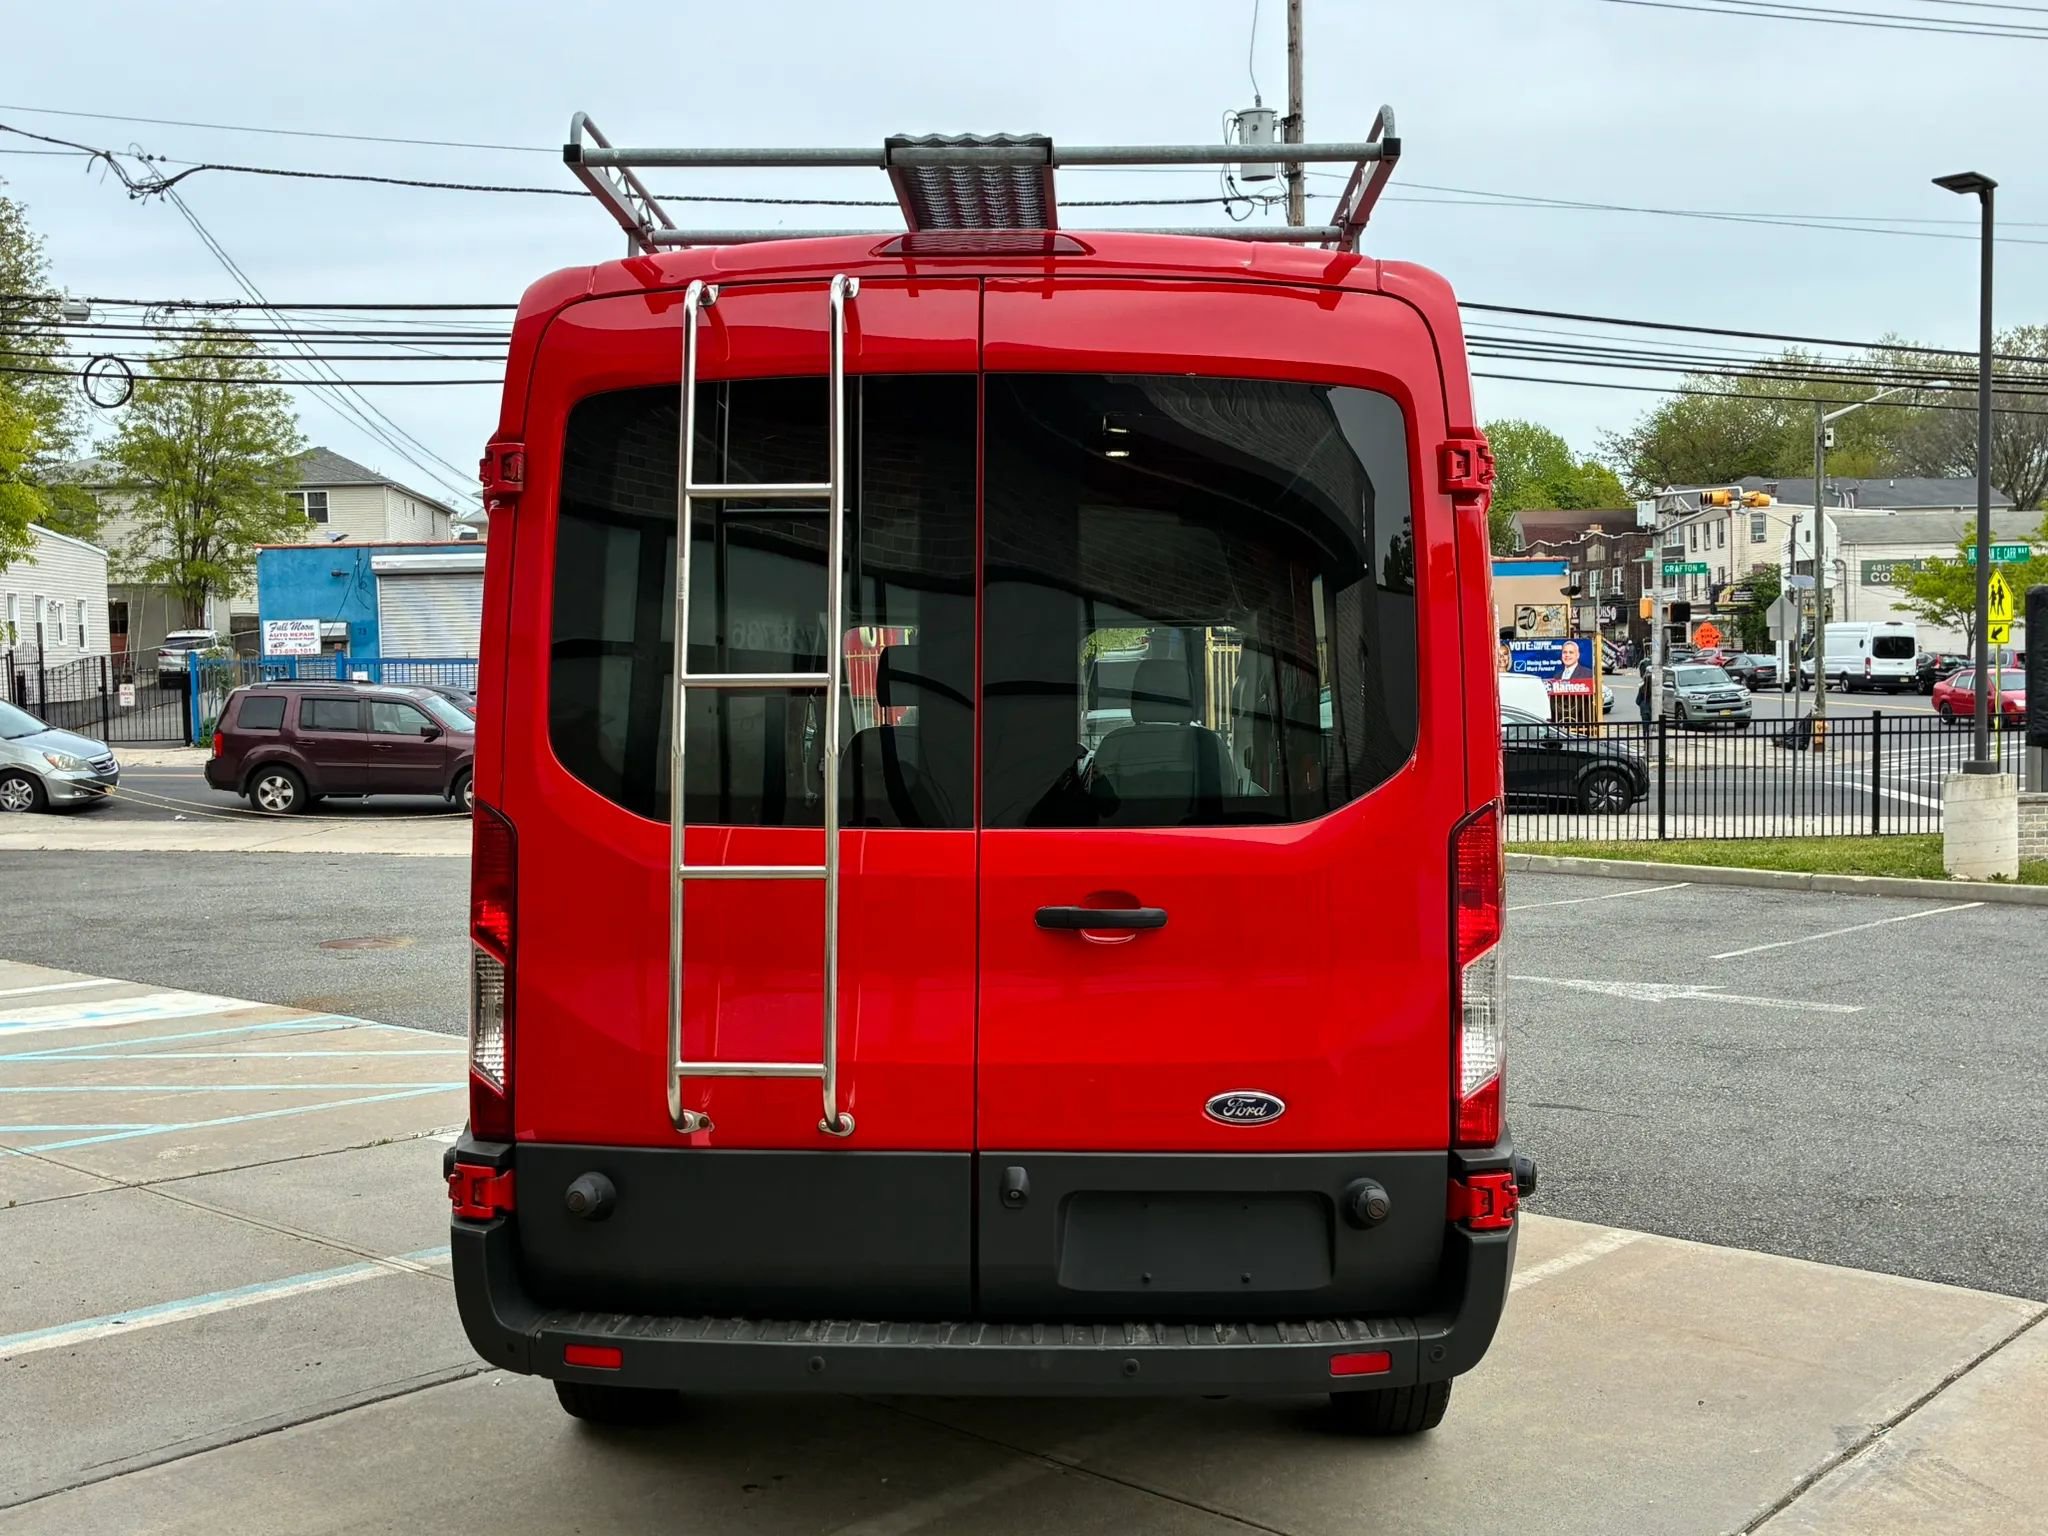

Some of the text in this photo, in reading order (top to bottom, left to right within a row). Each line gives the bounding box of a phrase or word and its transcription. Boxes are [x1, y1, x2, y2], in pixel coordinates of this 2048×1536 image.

[2004, 547, 2017, 560] CARR
[1664, 564, 1698, 573] GRAFTON
[269, 621, 315, 633] Full Moon
[1553, 681, 1586, 693] Ramos
[1223, 1097, 1267, 1116] Ford
